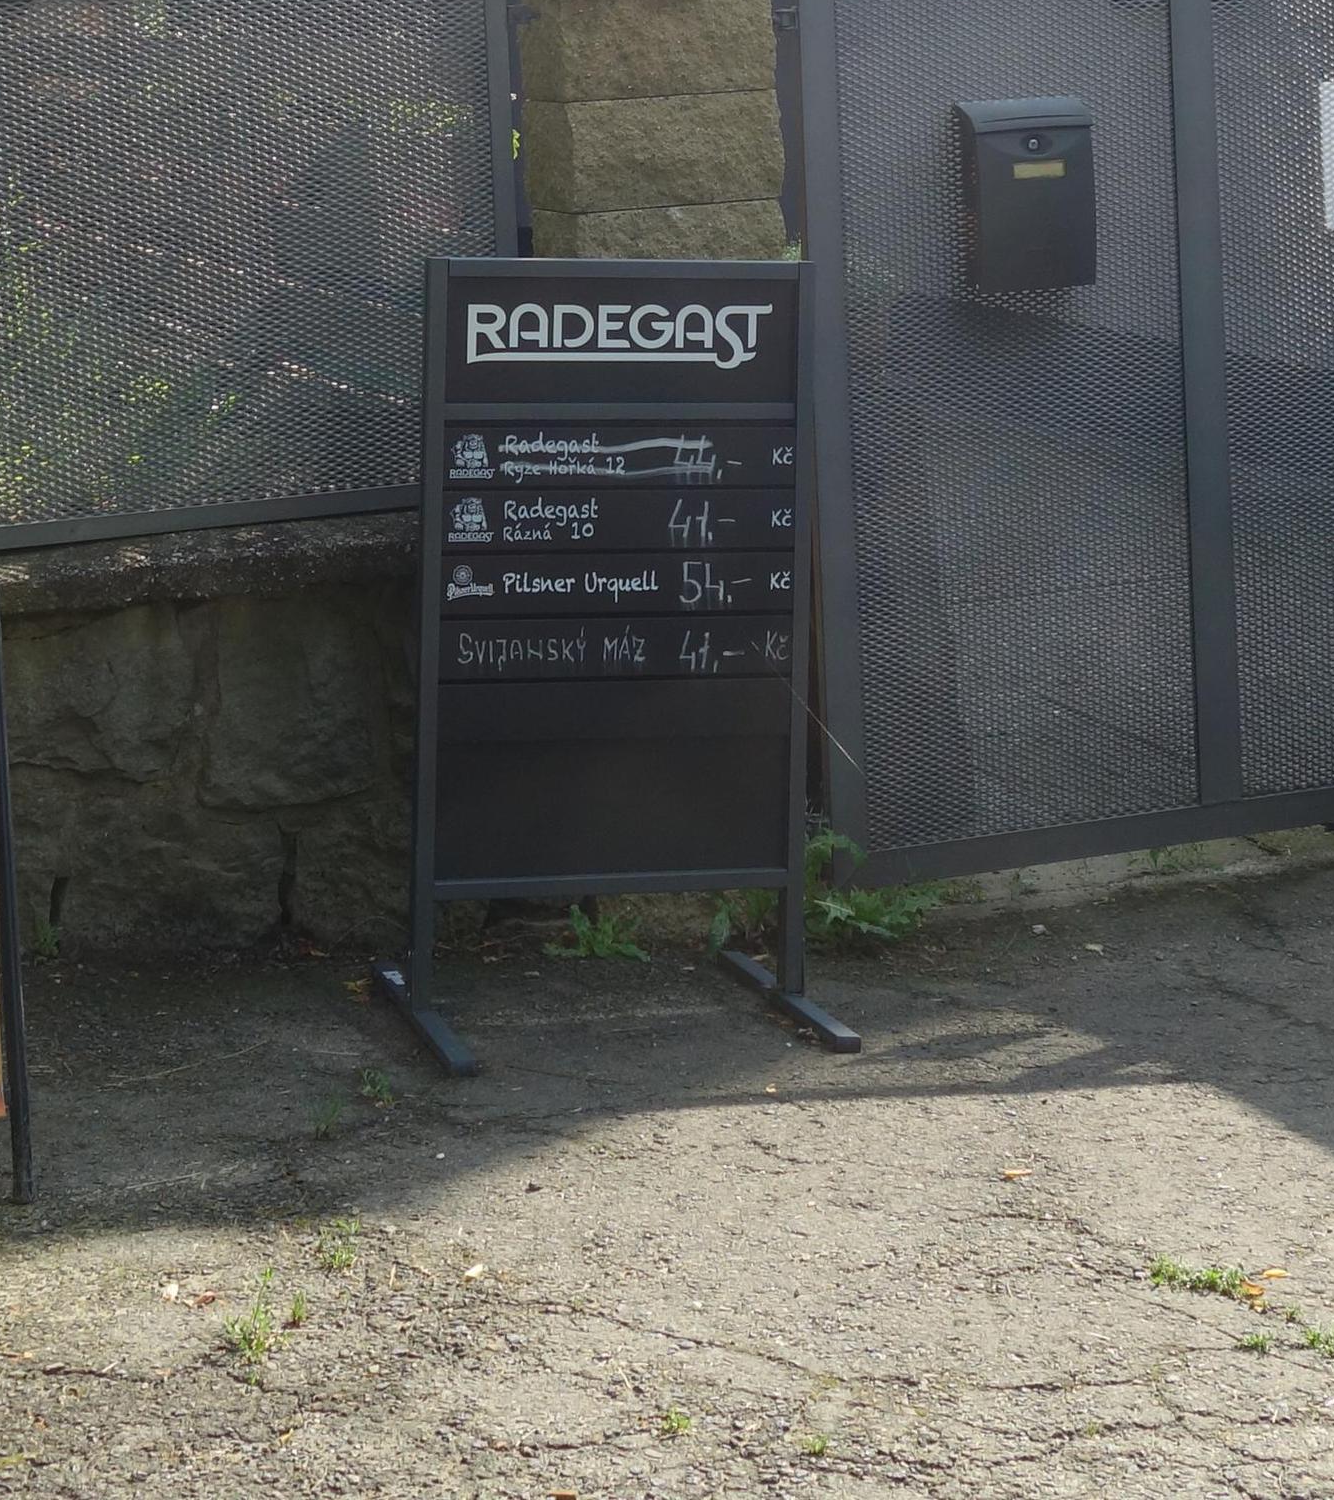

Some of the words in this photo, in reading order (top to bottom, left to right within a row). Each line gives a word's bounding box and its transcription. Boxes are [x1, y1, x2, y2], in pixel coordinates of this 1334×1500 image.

[467, 303, 772, 369] RADEGAST
[505, 431, 599, 460] Radegast
[549, 456, 596, 476] Hořká
[606, 456, 625, 475] 12
[772, 447, 793, 465] Kč
[449, 468, 495, 479] RADEGAST
[504, 497, 598, 526] Radegast
[771, 509, 792, 527] Kč
[448, 532, 494, 542] RADEGAST
[503, 522, 552, 541] Rázná
[571, 522, 594, 539] 10
[503, 572, 575, 594] Pilsner
[584, 570, 658, 603] Urquell
[770, 571, 791, 590] Kč
[765, 630, 789, 660] Kč
